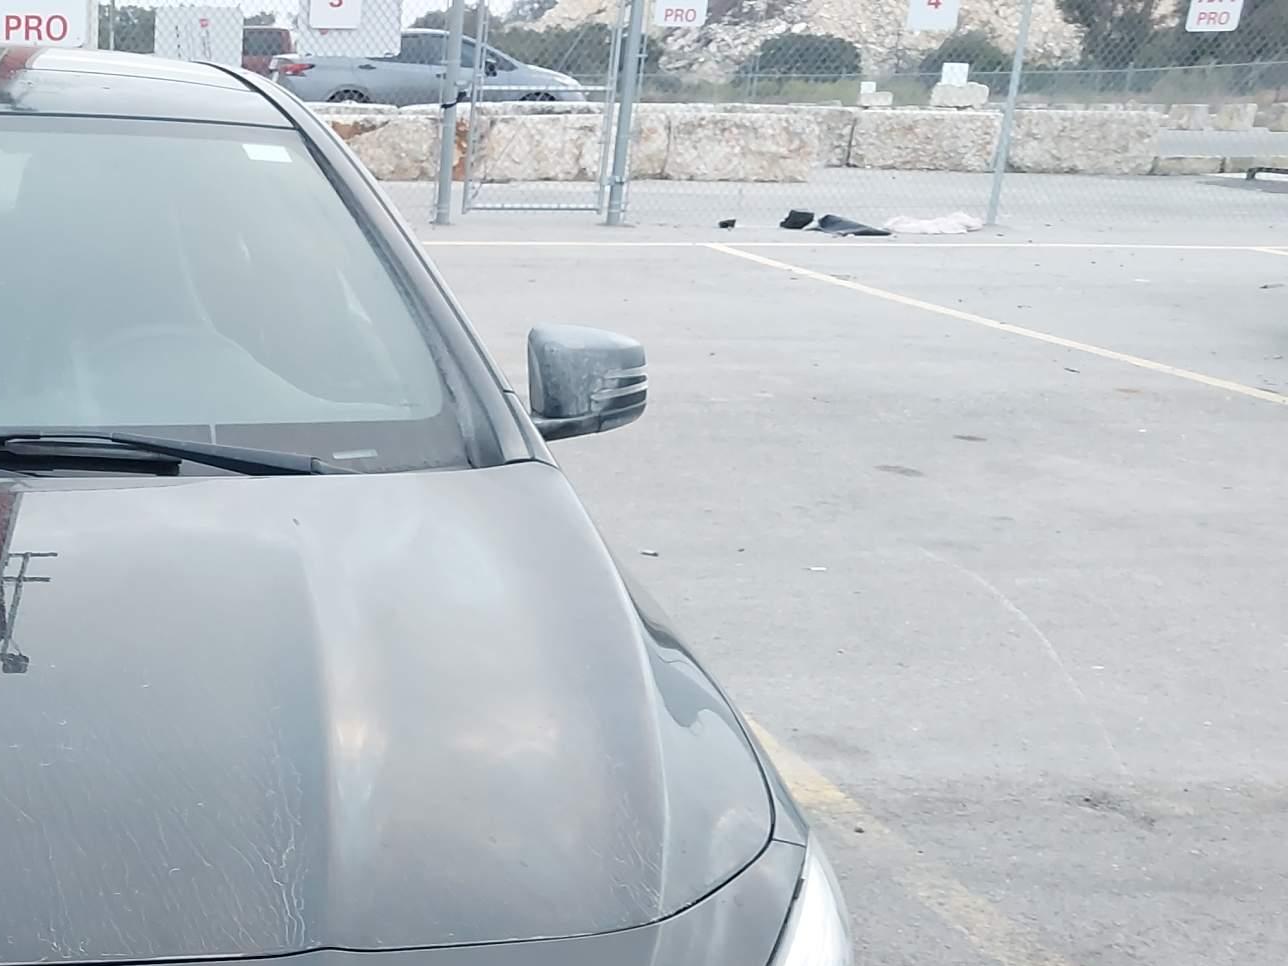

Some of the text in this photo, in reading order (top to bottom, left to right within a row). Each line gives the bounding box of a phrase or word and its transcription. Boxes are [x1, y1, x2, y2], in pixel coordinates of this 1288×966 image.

[664, 9, 696, 22] PRO
[1197, 12, 1230, 25] PRO
[5, 15, 67, 41] PRO
